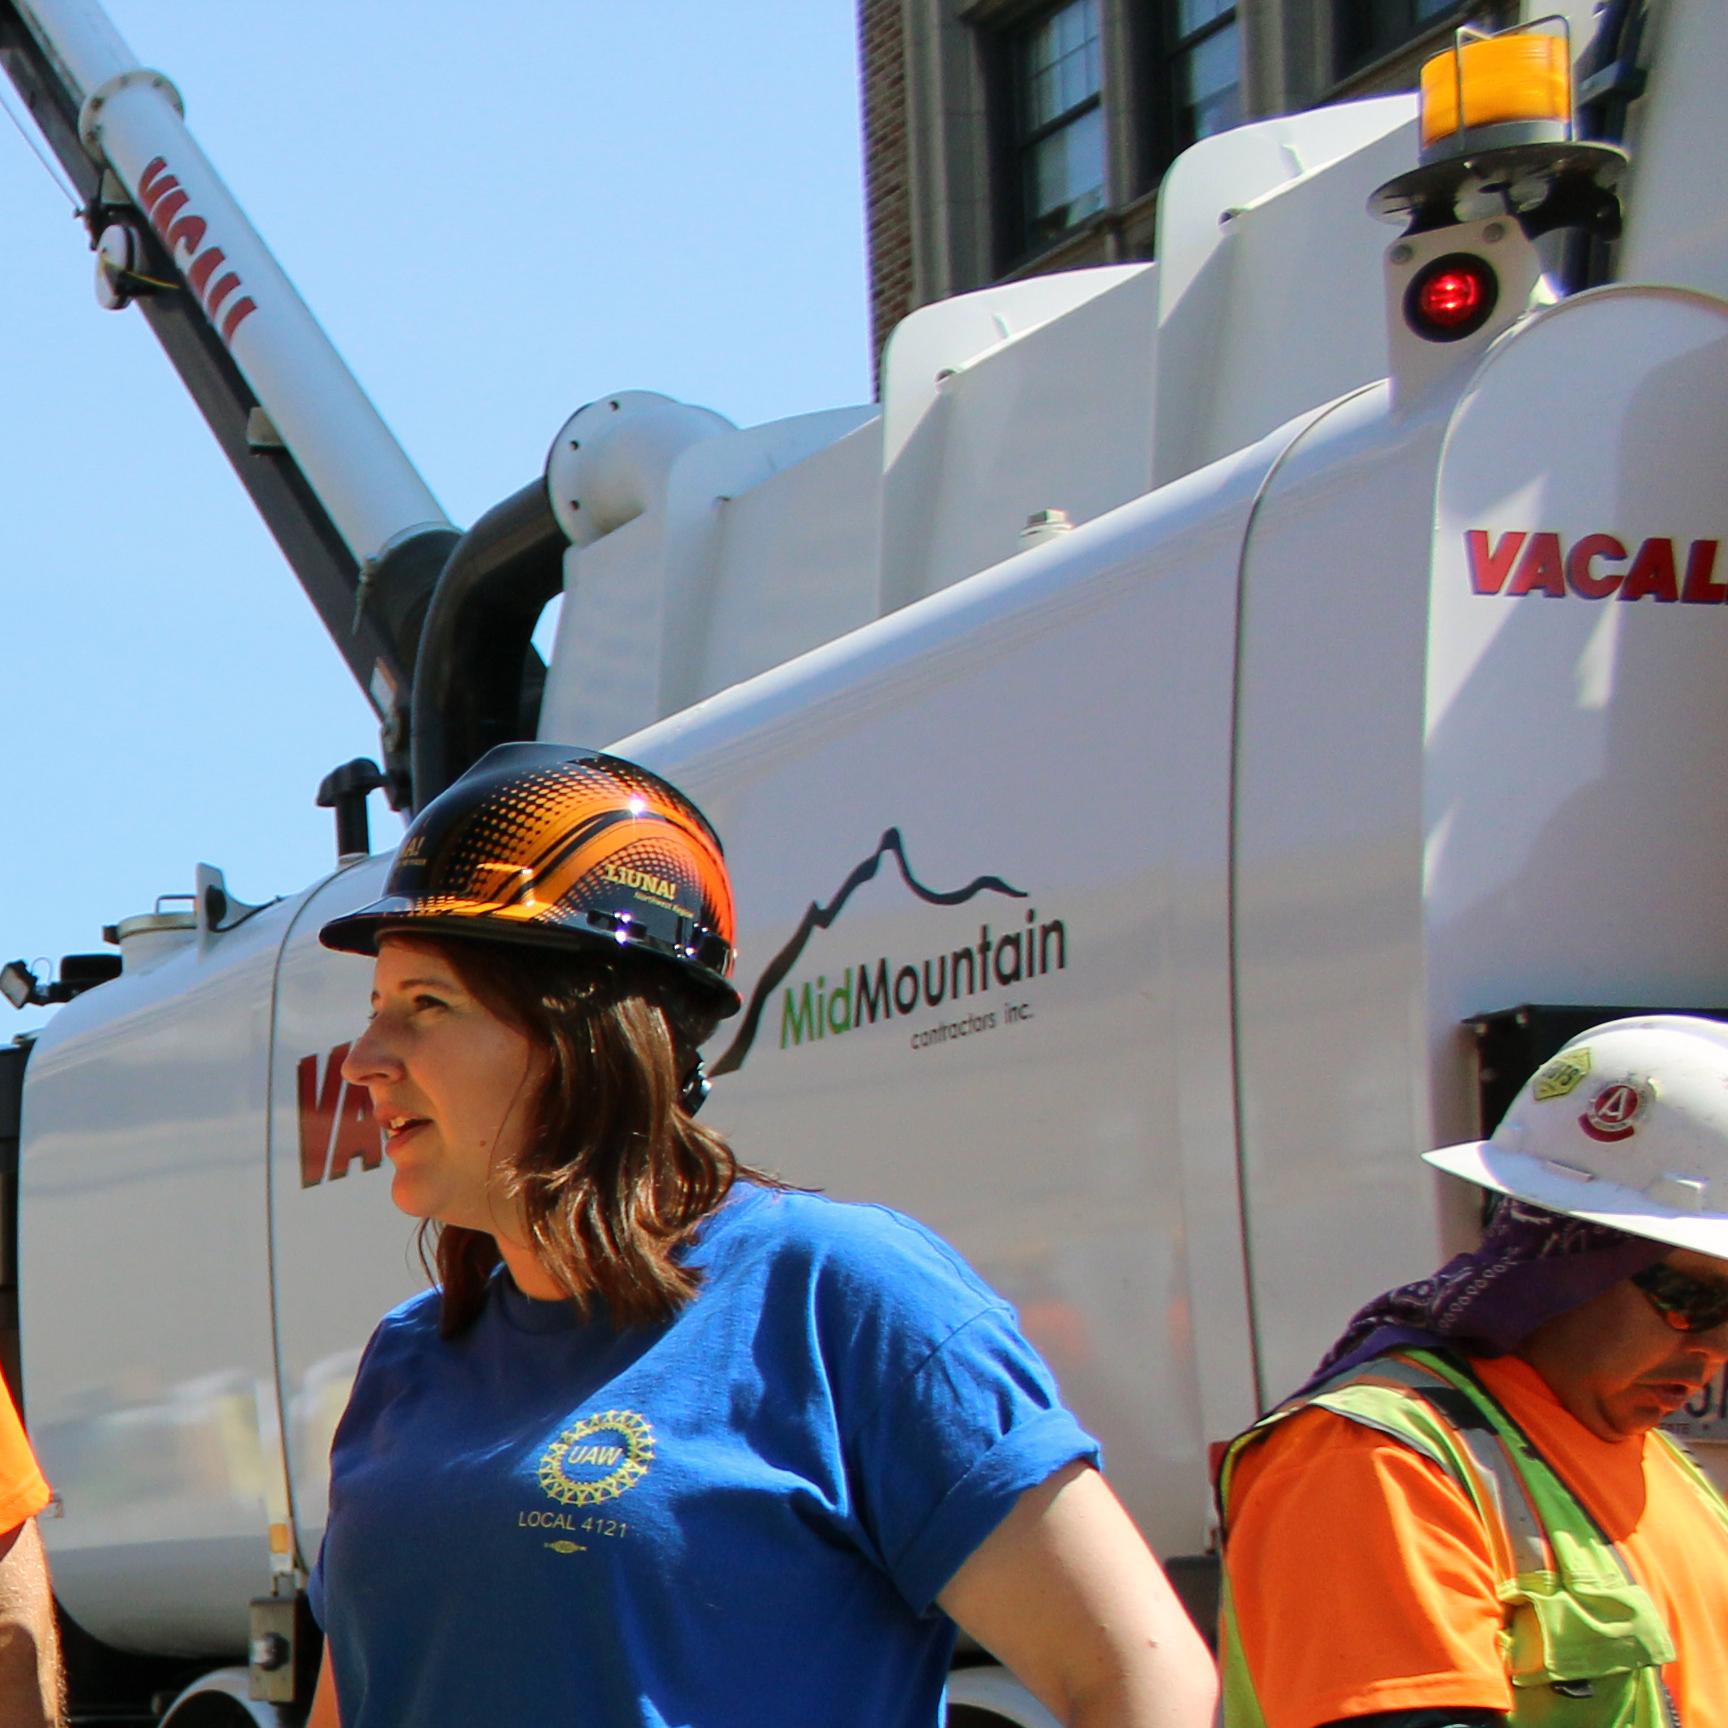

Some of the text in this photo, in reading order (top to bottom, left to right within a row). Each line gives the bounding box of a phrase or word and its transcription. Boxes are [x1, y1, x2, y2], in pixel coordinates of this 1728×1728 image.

[1462, 529, 1728, 605] VACAL
[780, 907, 1066, 1050] MidMountain
[566, 1444, 625, 1467] UAW
[518, 1510, 629, 1539] LOCAL 4121
